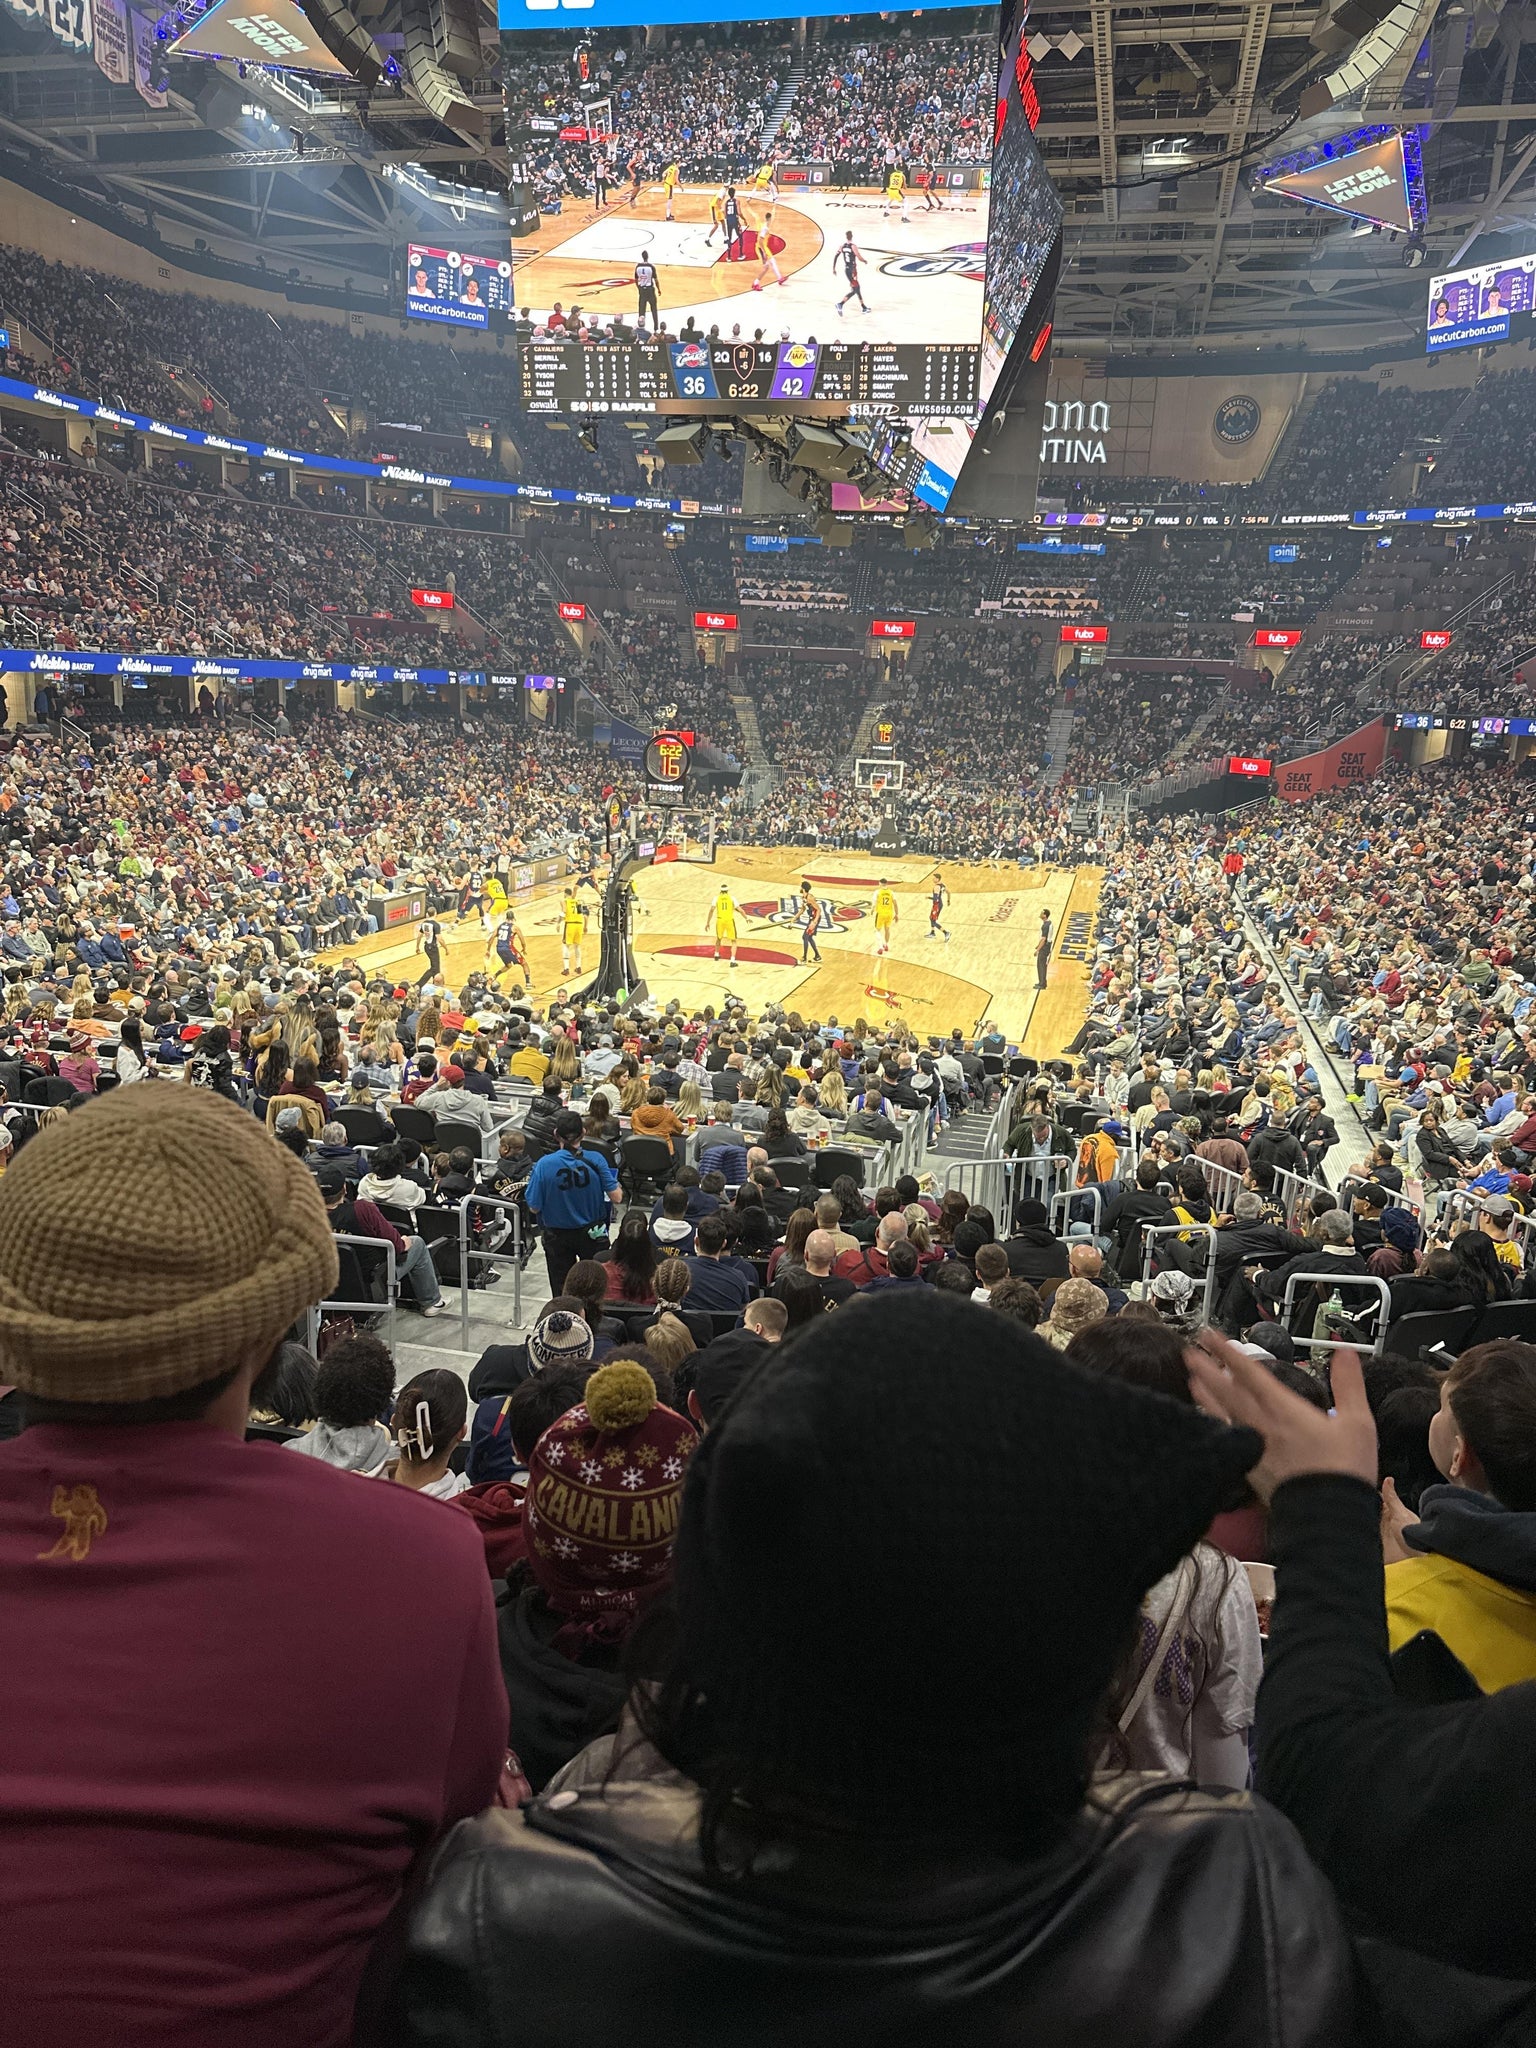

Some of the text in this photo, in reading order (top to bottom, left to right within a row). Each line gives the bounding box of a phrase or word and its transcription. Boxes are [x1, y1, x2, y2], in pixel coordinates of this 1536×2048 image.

[226, 18, 290, 58] KNOW.
[250, 14, 310, 52] LET EM
[1323, 166, 1386, 194] LET EM
[1331, 174, 1398, 204] KNOW.
[410, 300, 484, 322] WeCutCarbon.com
[1430, 323, 1505, 345] WeCutCarbon.com
[714, 351, 730, 362] 2Q
[758, 351, 772, 363] 16
[740, 362, 748, 370] -6
[684, 376, 803, 397] 36 6:22 42
[34, 390, 62, 408] Nickles
[530, 398, 559, 409] oswald
[612, 402, 656, 412] RAFFLE
[849, 404, 893, 418] $18,777
[908, 405, 974, 414] CAVS5050.COM
[1222, 400, 1254, 412] CLEVELAND
[95, 406, 120, 422] Nickles
[149, 422, 172, 437] Nickles
[1220, 429, 1250, 440] MONSTERS
[203, 435, 231, 450] Nickles
[264, 447, 289, 462] Nickles
[381, 466, 452, 487] Nickles BAKERY
[518, 486, 552, 498] drug mart
[575, 493, 610, 504] drug mart
[635, 499, 652, 509] drug
[653, 500, 670, 509] mart
[701, 503, 722, 511] oswald
[1503, 506, 1523, 516] drug
[1056, 515, 1067, 524] 42
[1282, 514, 1350, 524] LET EM KNOW.
[1366, 512, 1406, 522] drug mart
[1435, 508, 1476, 520] drug mart
[1110, 516, 1269, 525] FG% 50 FOULS 0 TOL 5 7:56 PM
[424, 594, 441, 604] fubo
[642, 598, 677, 606] LITEHOUSE
[563, 606, 581, 616] fubo
[707, 617, 725, 626] fubo
[885, 625, 903, 633] fubo
[1075, 629, 1094, 639] fubo
[1268, 633, 1288, 643] fubo
[30, 654, 95, 671] Nickles BAKERY
[117, 658, 172, 673] Nickles BAKERY
[191, 660, 222, 674] Nickles
[303, 667, 332, 679] drug mart
[351, 668, 377, 680] drug mart
[393, 670, 418, 681] drug mart
[492, 676, 517, 685] BLOCKS
[1417, 716, 1428, 727] 36
[1450, 719, 1466, 729] 6:22
[1483, 720, 1493, 731] 42
[879, 724, 892, 732] 6:22
[880, 732, 890, 742] 16
[659, 745, 683, 756] 6:22
[1340, 752, 1366, 764] SEAT
[663, 757, 680, 776] 16
[1242, 762, 1258, 771] fubo
[1337, 766, 1364, 778] GEEK
[1286, 773, 1312, 782] SEAT
[1284, 783, 1312, 792] GEEK
[882, 897, 889, 905] 12
[388, 906, 408, 922] ESPN
[556, 1166, 590, 1191] 30
